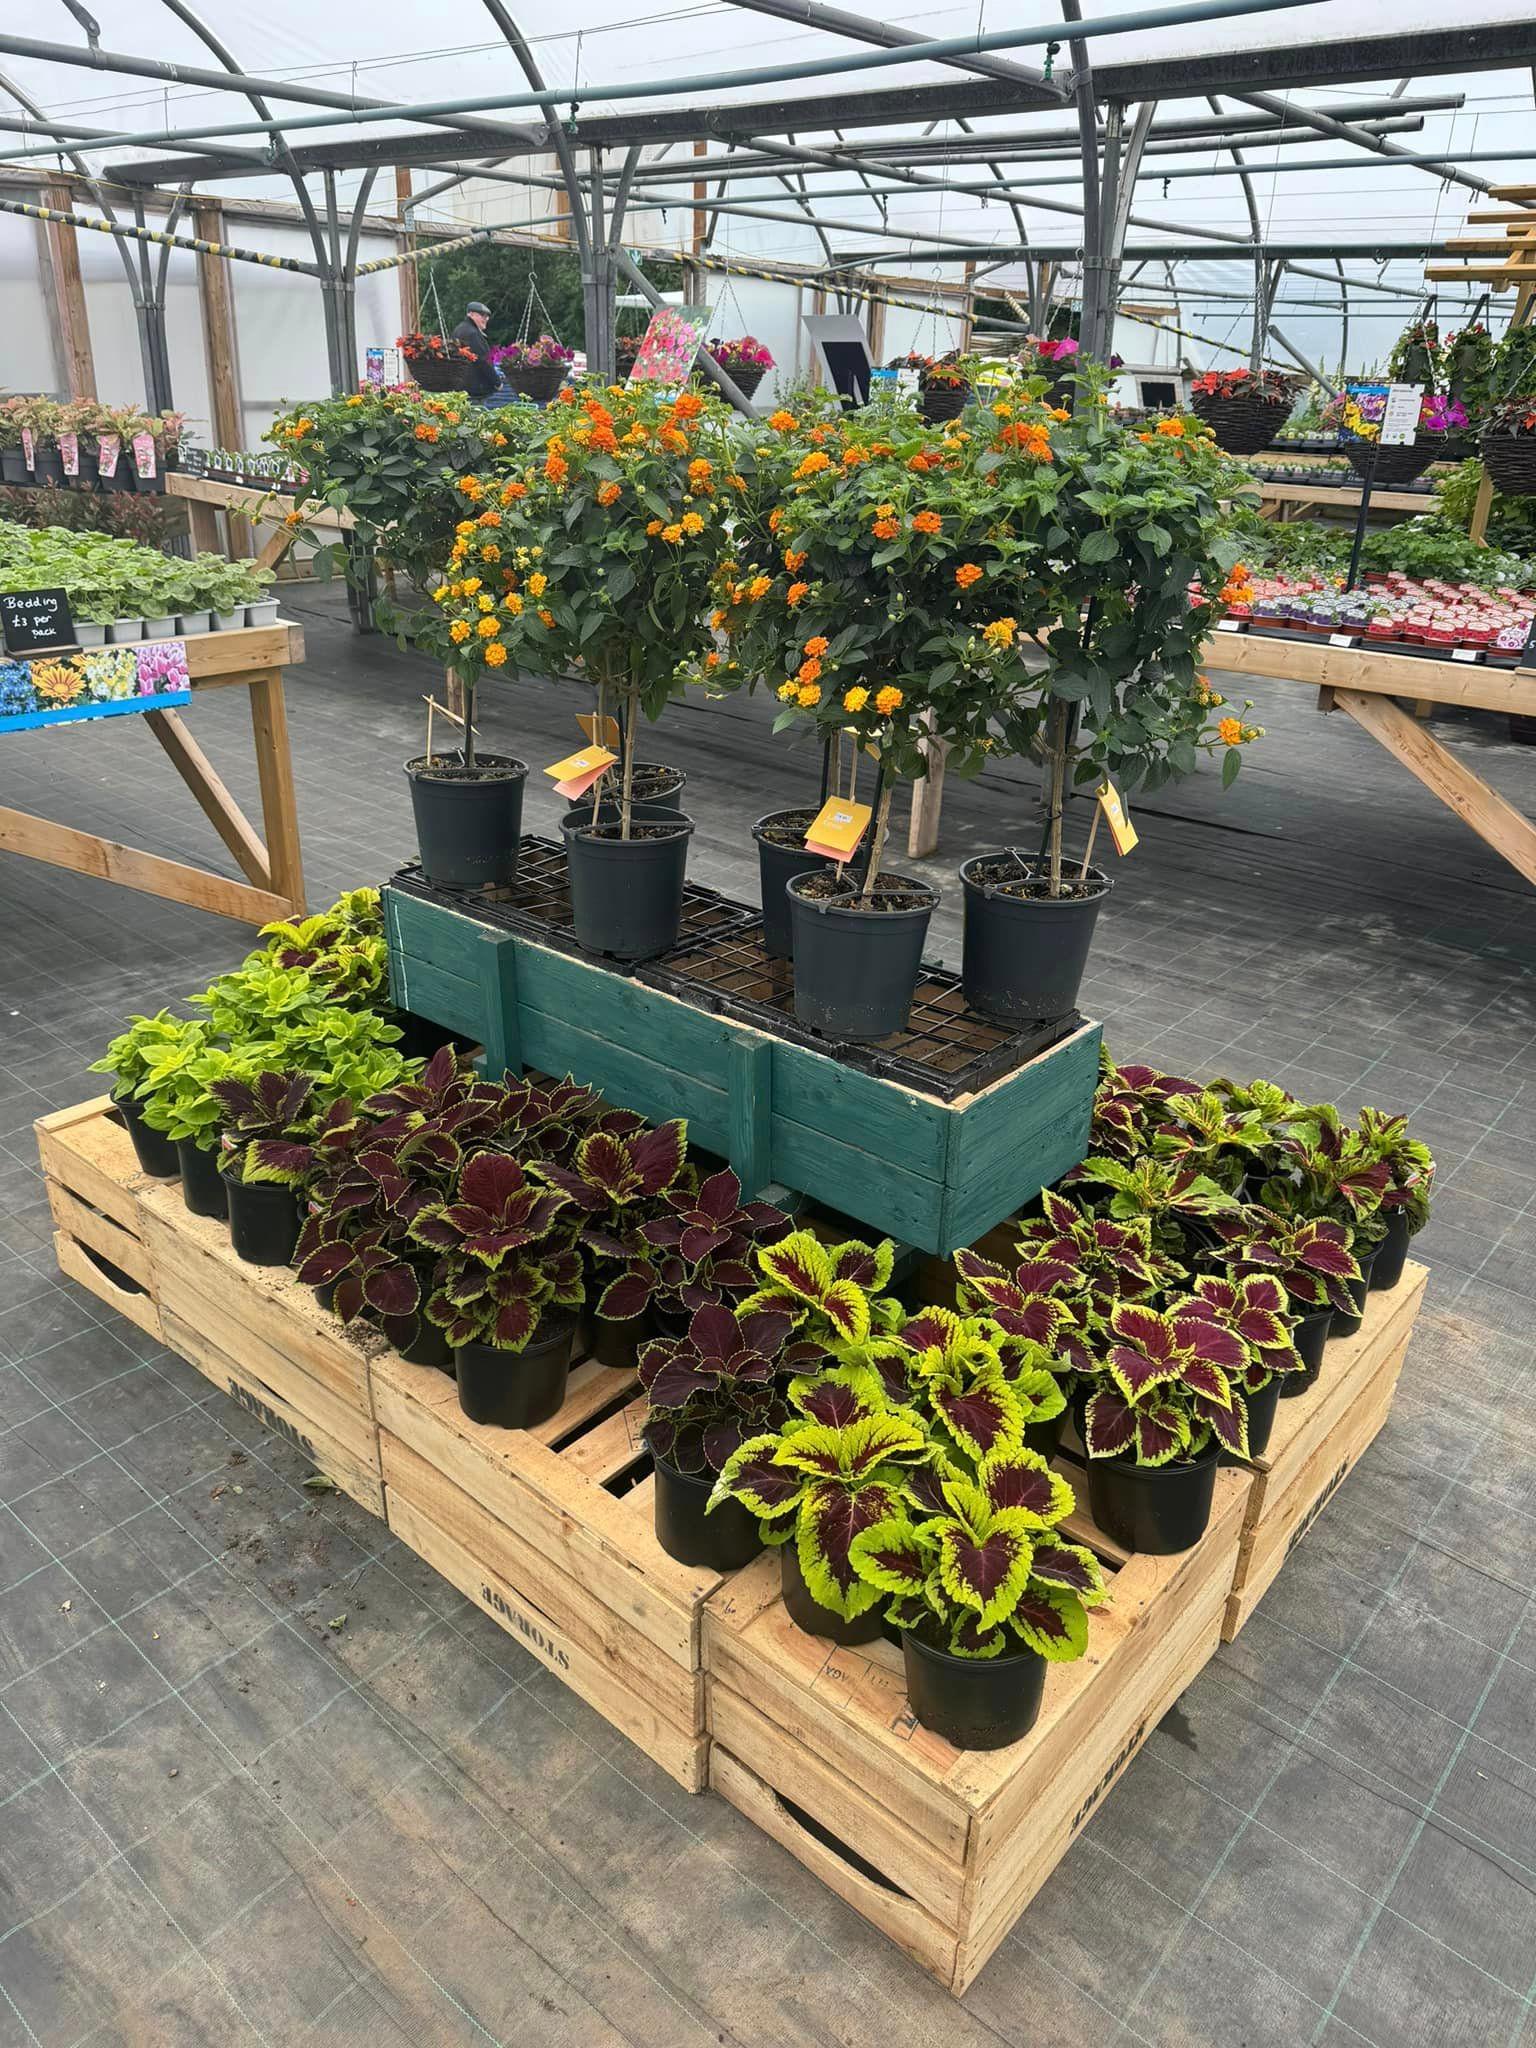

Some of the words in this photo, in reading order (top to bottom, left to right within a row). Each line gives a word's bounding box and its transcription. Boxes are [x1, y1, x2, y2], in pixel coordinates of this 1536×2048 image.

[3, 596, 58, 612] Bedding
[12, 614, 28, 627] £3
[33, 615, 52, 627] per
[31, 628, 57, 640] pack
[481, 1582, 570, 1670] STORAGE
